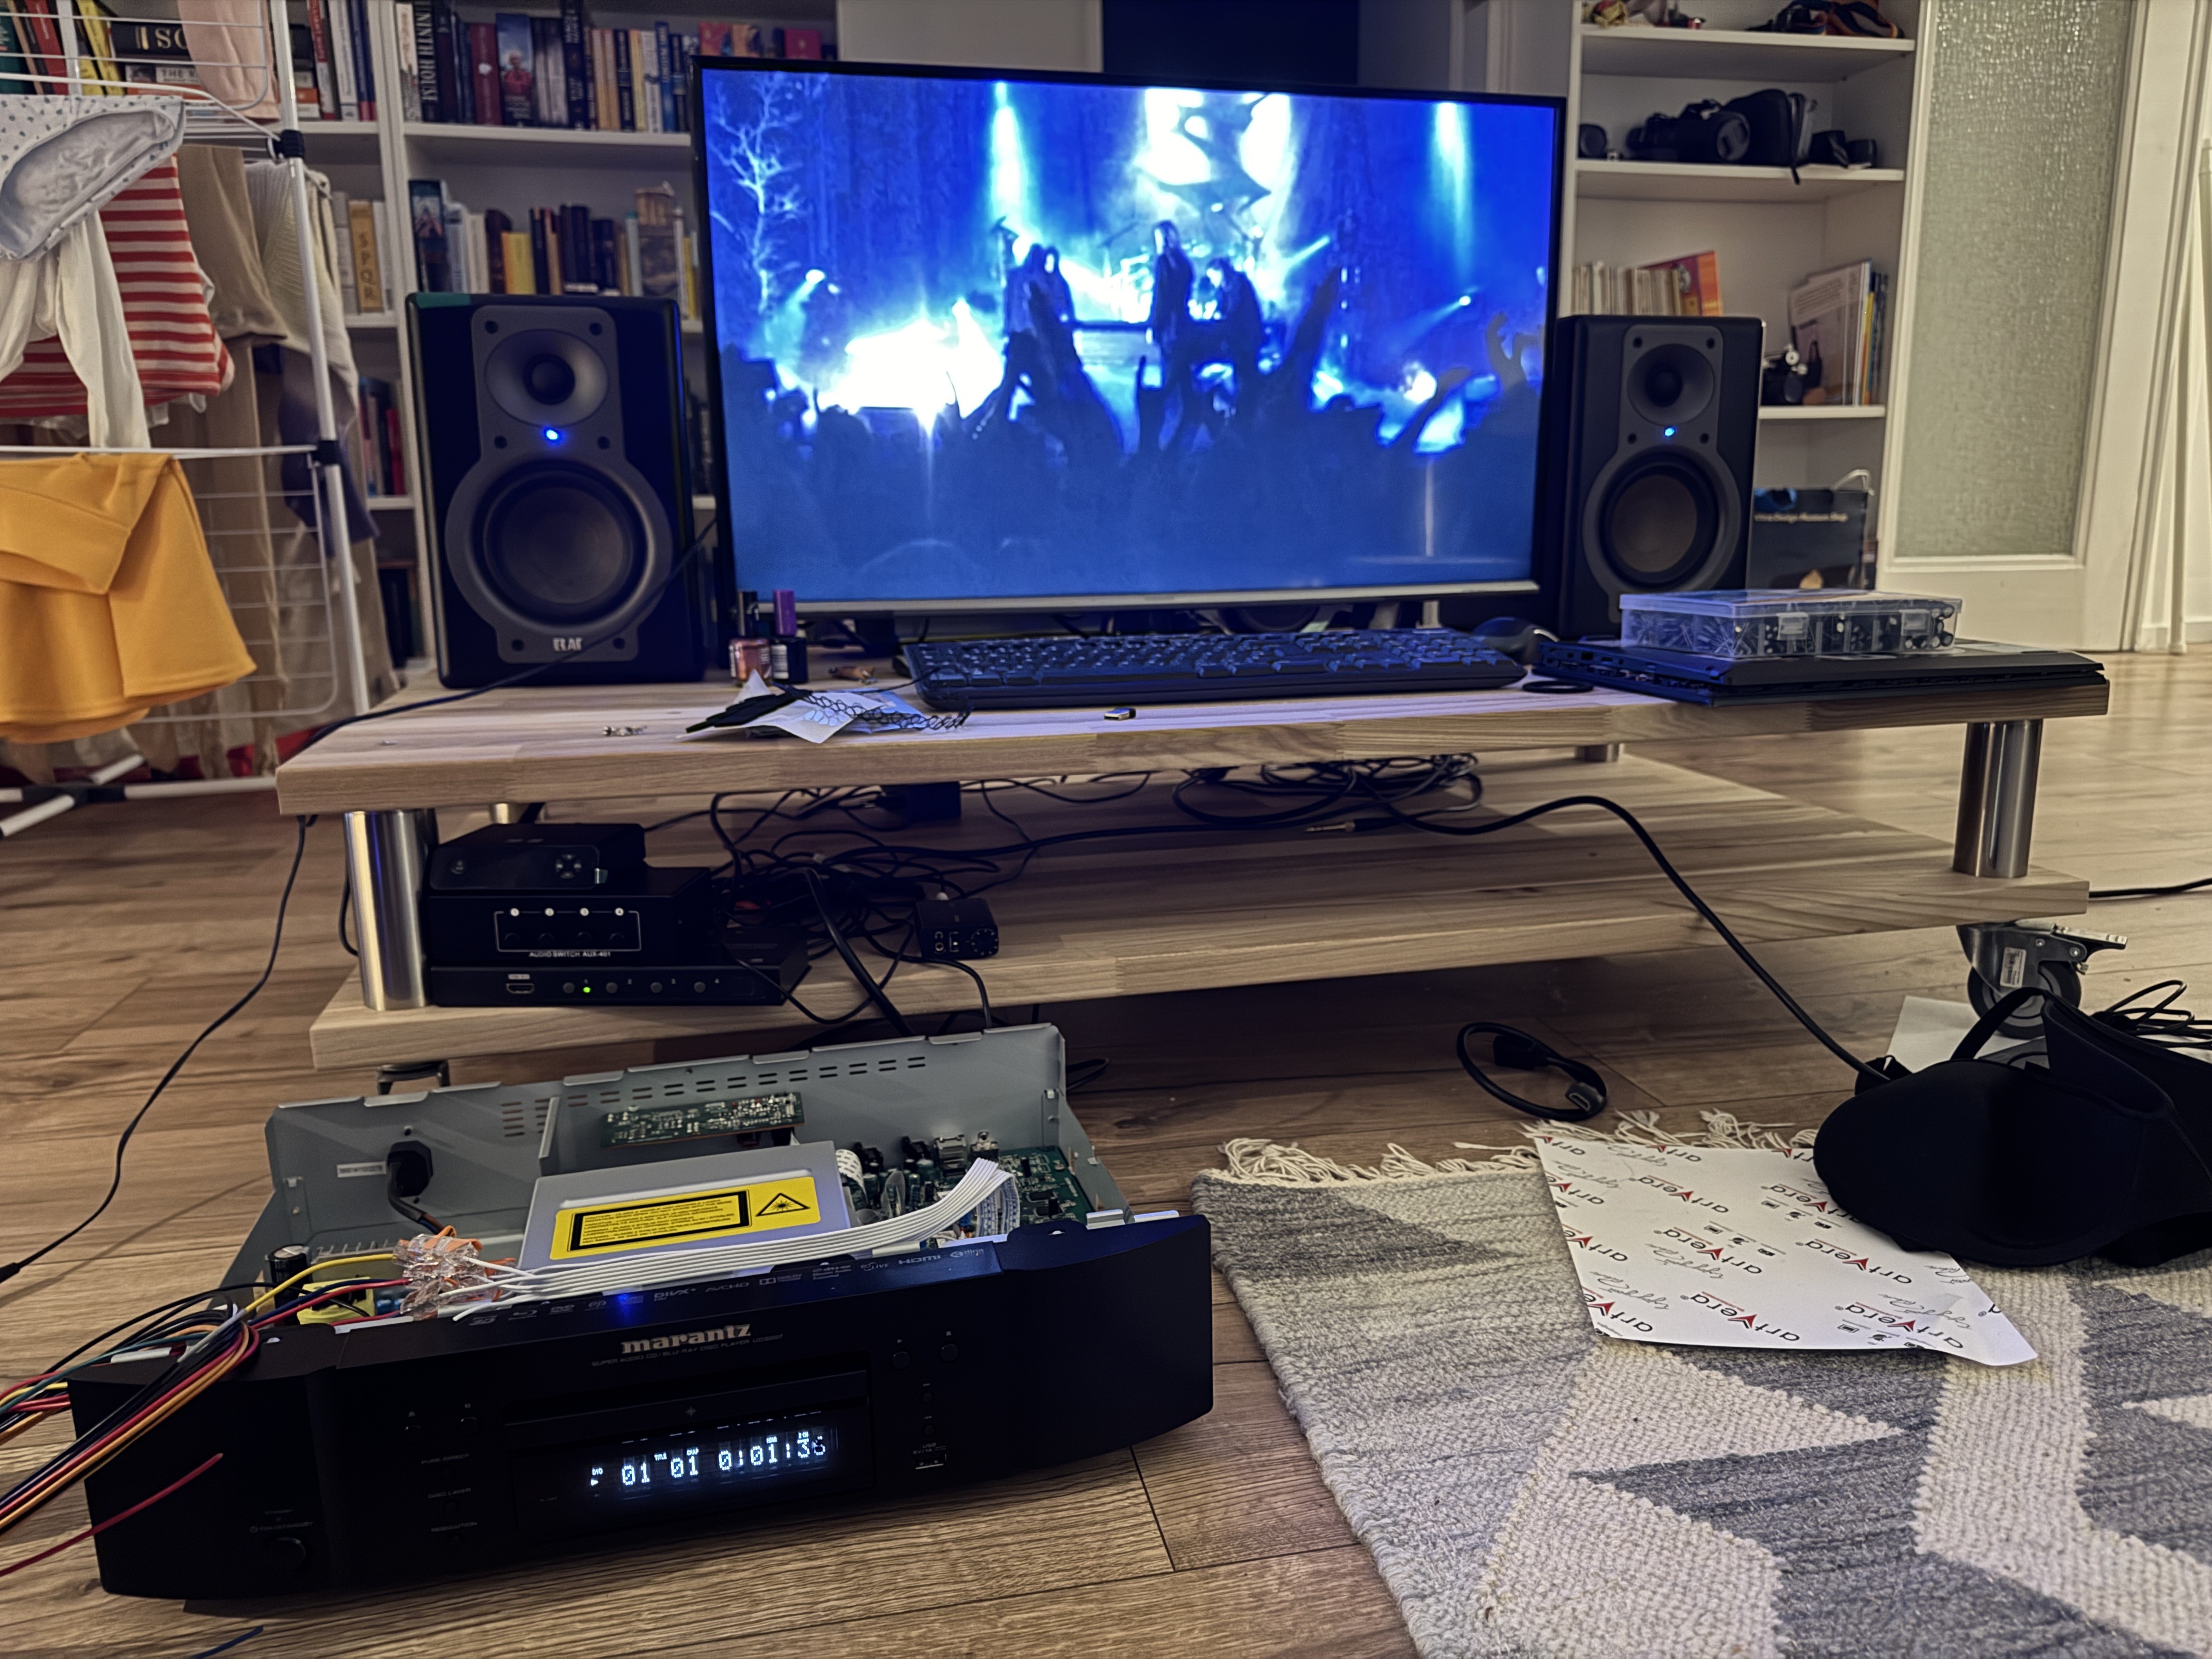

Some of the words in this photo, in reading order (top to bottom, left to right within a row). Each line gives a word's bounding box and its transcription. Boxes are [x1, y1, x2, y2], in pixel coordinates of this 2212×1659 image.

[415, 13, 434, 55] NINTH
[620, 1324, 751, 1355] marantz
[592, 1468, 603, 1476] DVD
[622, 1462, 650, 1486] 01
[670, 1455, 698, 1479] 01
[654, 1452, 667, 1461] TITLE
